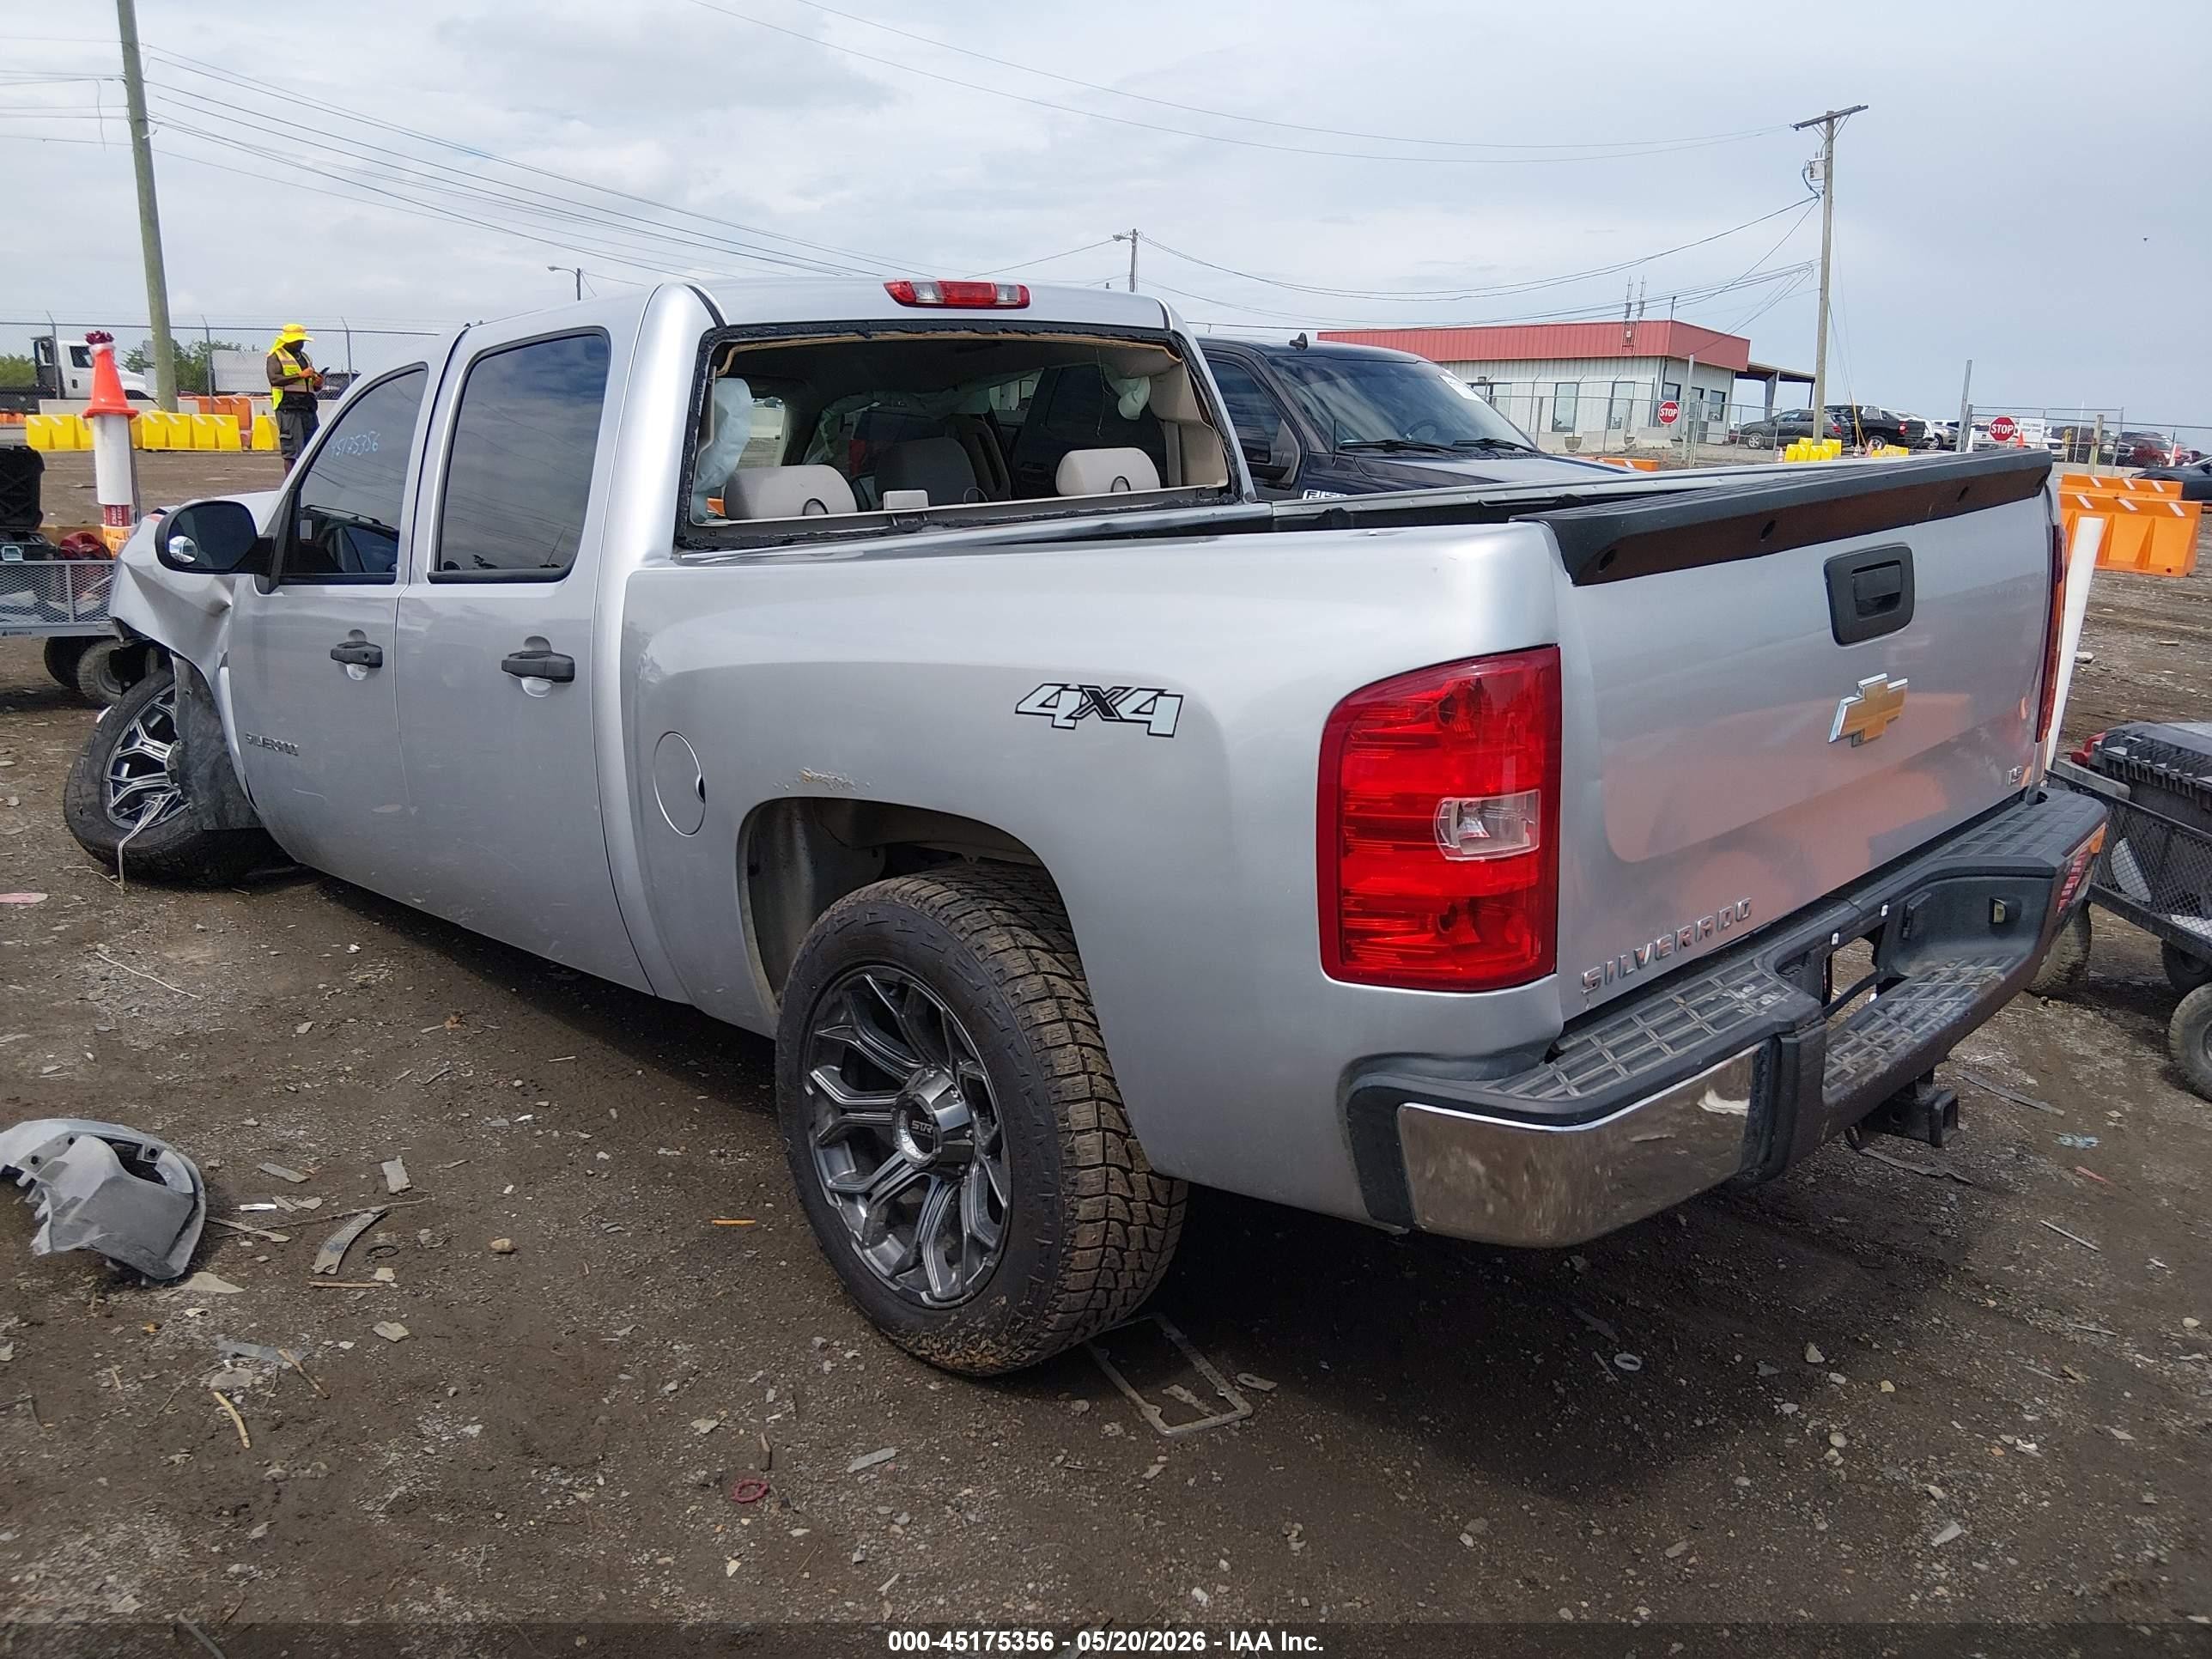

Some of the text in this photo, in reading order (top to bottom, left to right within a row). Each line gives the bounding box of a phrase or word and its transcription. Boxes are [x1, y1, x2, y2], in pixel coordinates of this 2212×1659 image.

[1659, 408, 1678, 417] STOP
[1990, 424, 2014, 434] STOP
[1581, 897, 1752, 994] SILVERADO
[911, 1120, 933, 1134] STR
